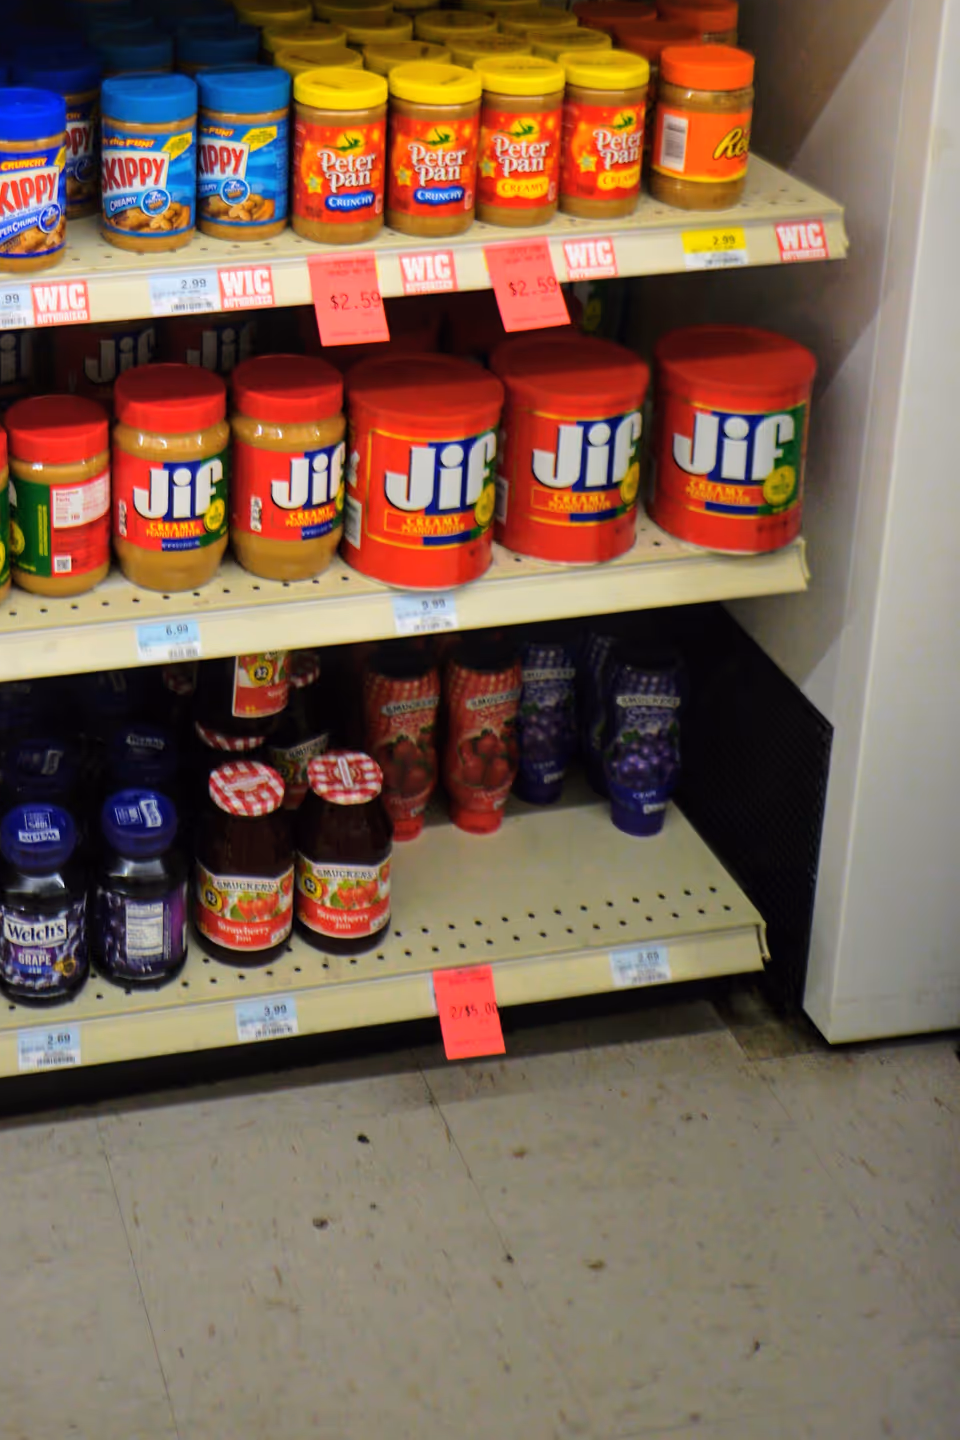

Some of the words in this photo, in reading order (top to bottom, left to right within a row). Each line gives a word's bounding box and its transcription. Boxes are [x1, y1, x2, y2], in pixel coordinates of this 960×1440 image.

[209, 127, 235, 138] FUN!
[492, 135, 550, 163] Peter
[593, 129, 641, 155] Peter
[1, 157, 47, 171] CRUNCHY
[317, 149, 377, 178] Peter
[407, 143, 467, 172] Peter
[101, 157, 166, 193] SKIPPY
[418, 162, 462, 189] Pan
[501, 155, 546, 182] Pan
[329, 168, 372, 194] Pan
[500, 180, 546, 196] CREAMY
[109, 195, 138, 211] CREAMY
[327, 194, 374, 210] CRUNCHY
[416, 187, 464, 202] CRUNCHY
[712, 235, 736, 246] 2.99
[775, 223, 824, 250] WIC
[565, 240, 613, 268] WIC
[404, 256, 451, 283] WIC
[181, 279, 207, 290] 2.99
[220, 269, 271, 296] WIC
[508, 277, 558, 297] $2.59
[33, 285, 86, 312] WIC
[223, 294, 275, 308] AUTHORIZED
[330, 293, 382, 310] $2.59
[36, 311, 89, 325] AUTHORIZED
[532, 411, 642, 490] Jif
[672, 409, 796, 482] Jif
[271, 443, 344, 511] Jif
[384, 433, 496, 511] Jif
[132, 459, 224, 520] Jif
[552, 490, 607, 503] CREAMY
[689, 481, 745, 495] CREAMY
[147, 522, 196, 533] CREAMY
[405, 514, 462, 527] CREAMY
[165, 624, 188, 636] 6.99
[317, 909, 369, 924] Strawberry
[5, 921, 65, 944] Welch's
[217, 921, 271, 938] Strawberry
[18, 953, 52, 967] GRAPE
[263, 1004, 287, 1016] 3.99
[46, 1033, 71, 1045] 2.69
